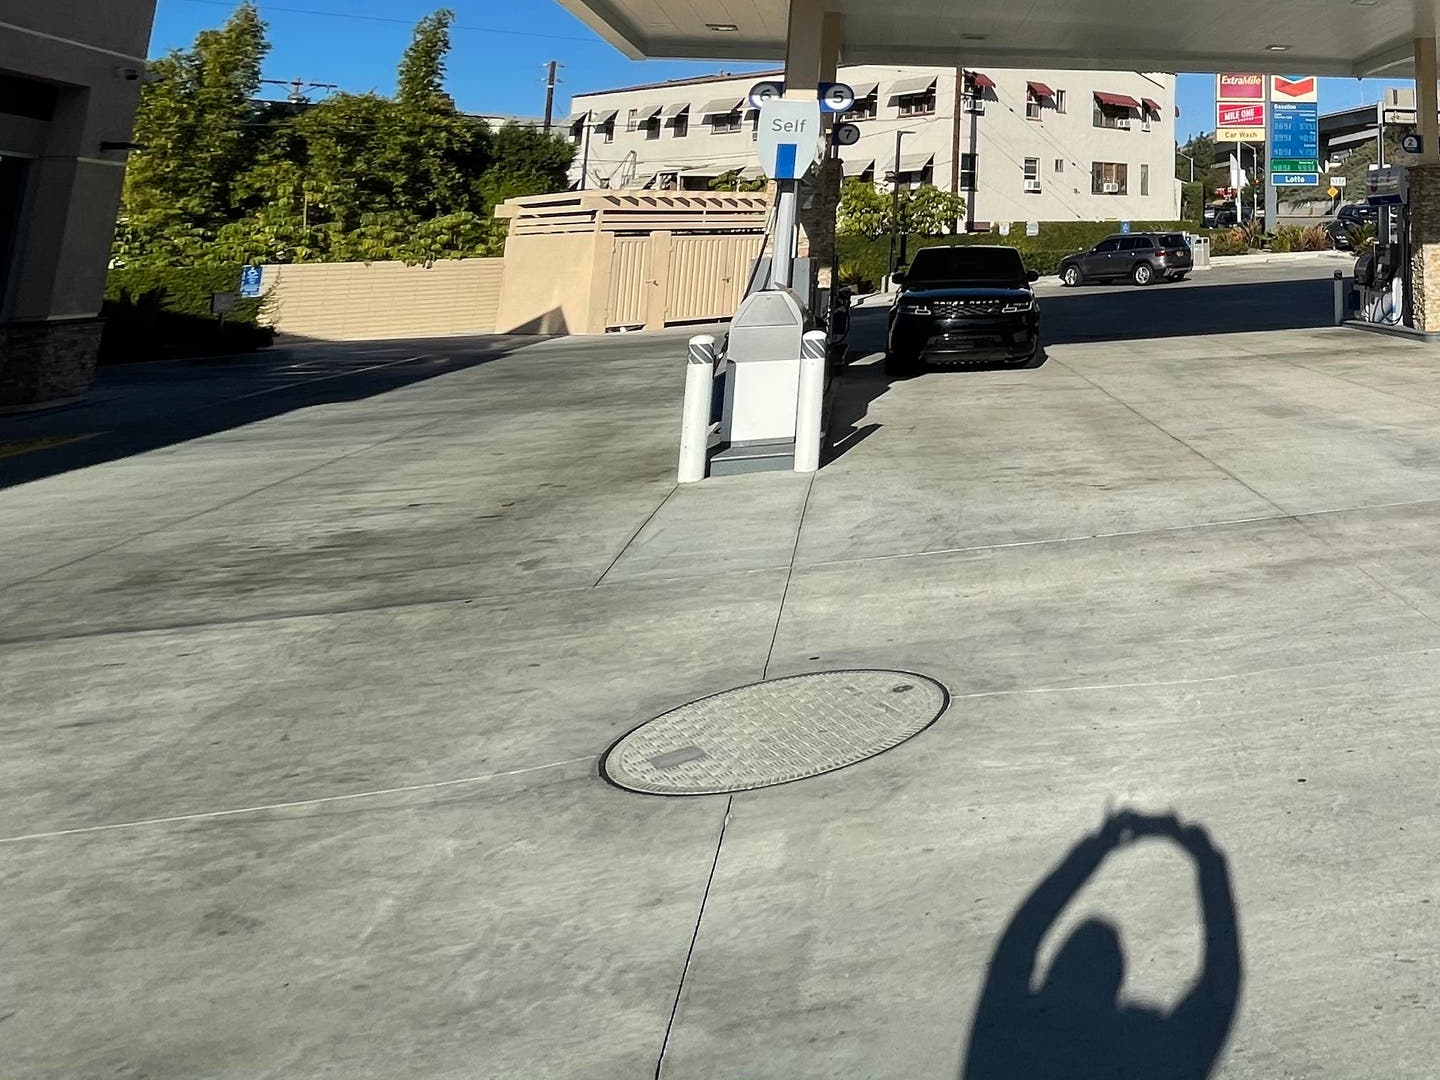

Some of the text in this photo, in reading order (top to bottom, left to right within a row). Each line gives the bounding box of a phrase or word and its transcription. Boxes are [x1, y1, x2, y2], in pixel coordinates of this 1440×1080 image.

[1221, 75, 1261, 85] ExtraMile
[832, 90, 844, 103] 5
[1224, 110, 1240, 121] MILE
[1241, 108, 1255, 119] ONE
[771, 118, 807, 133] Self
[843, 129, 853, 140] 7
[1407, 139, 1414, 147] 2
[1285, 175, 1305, 183] Lotto
